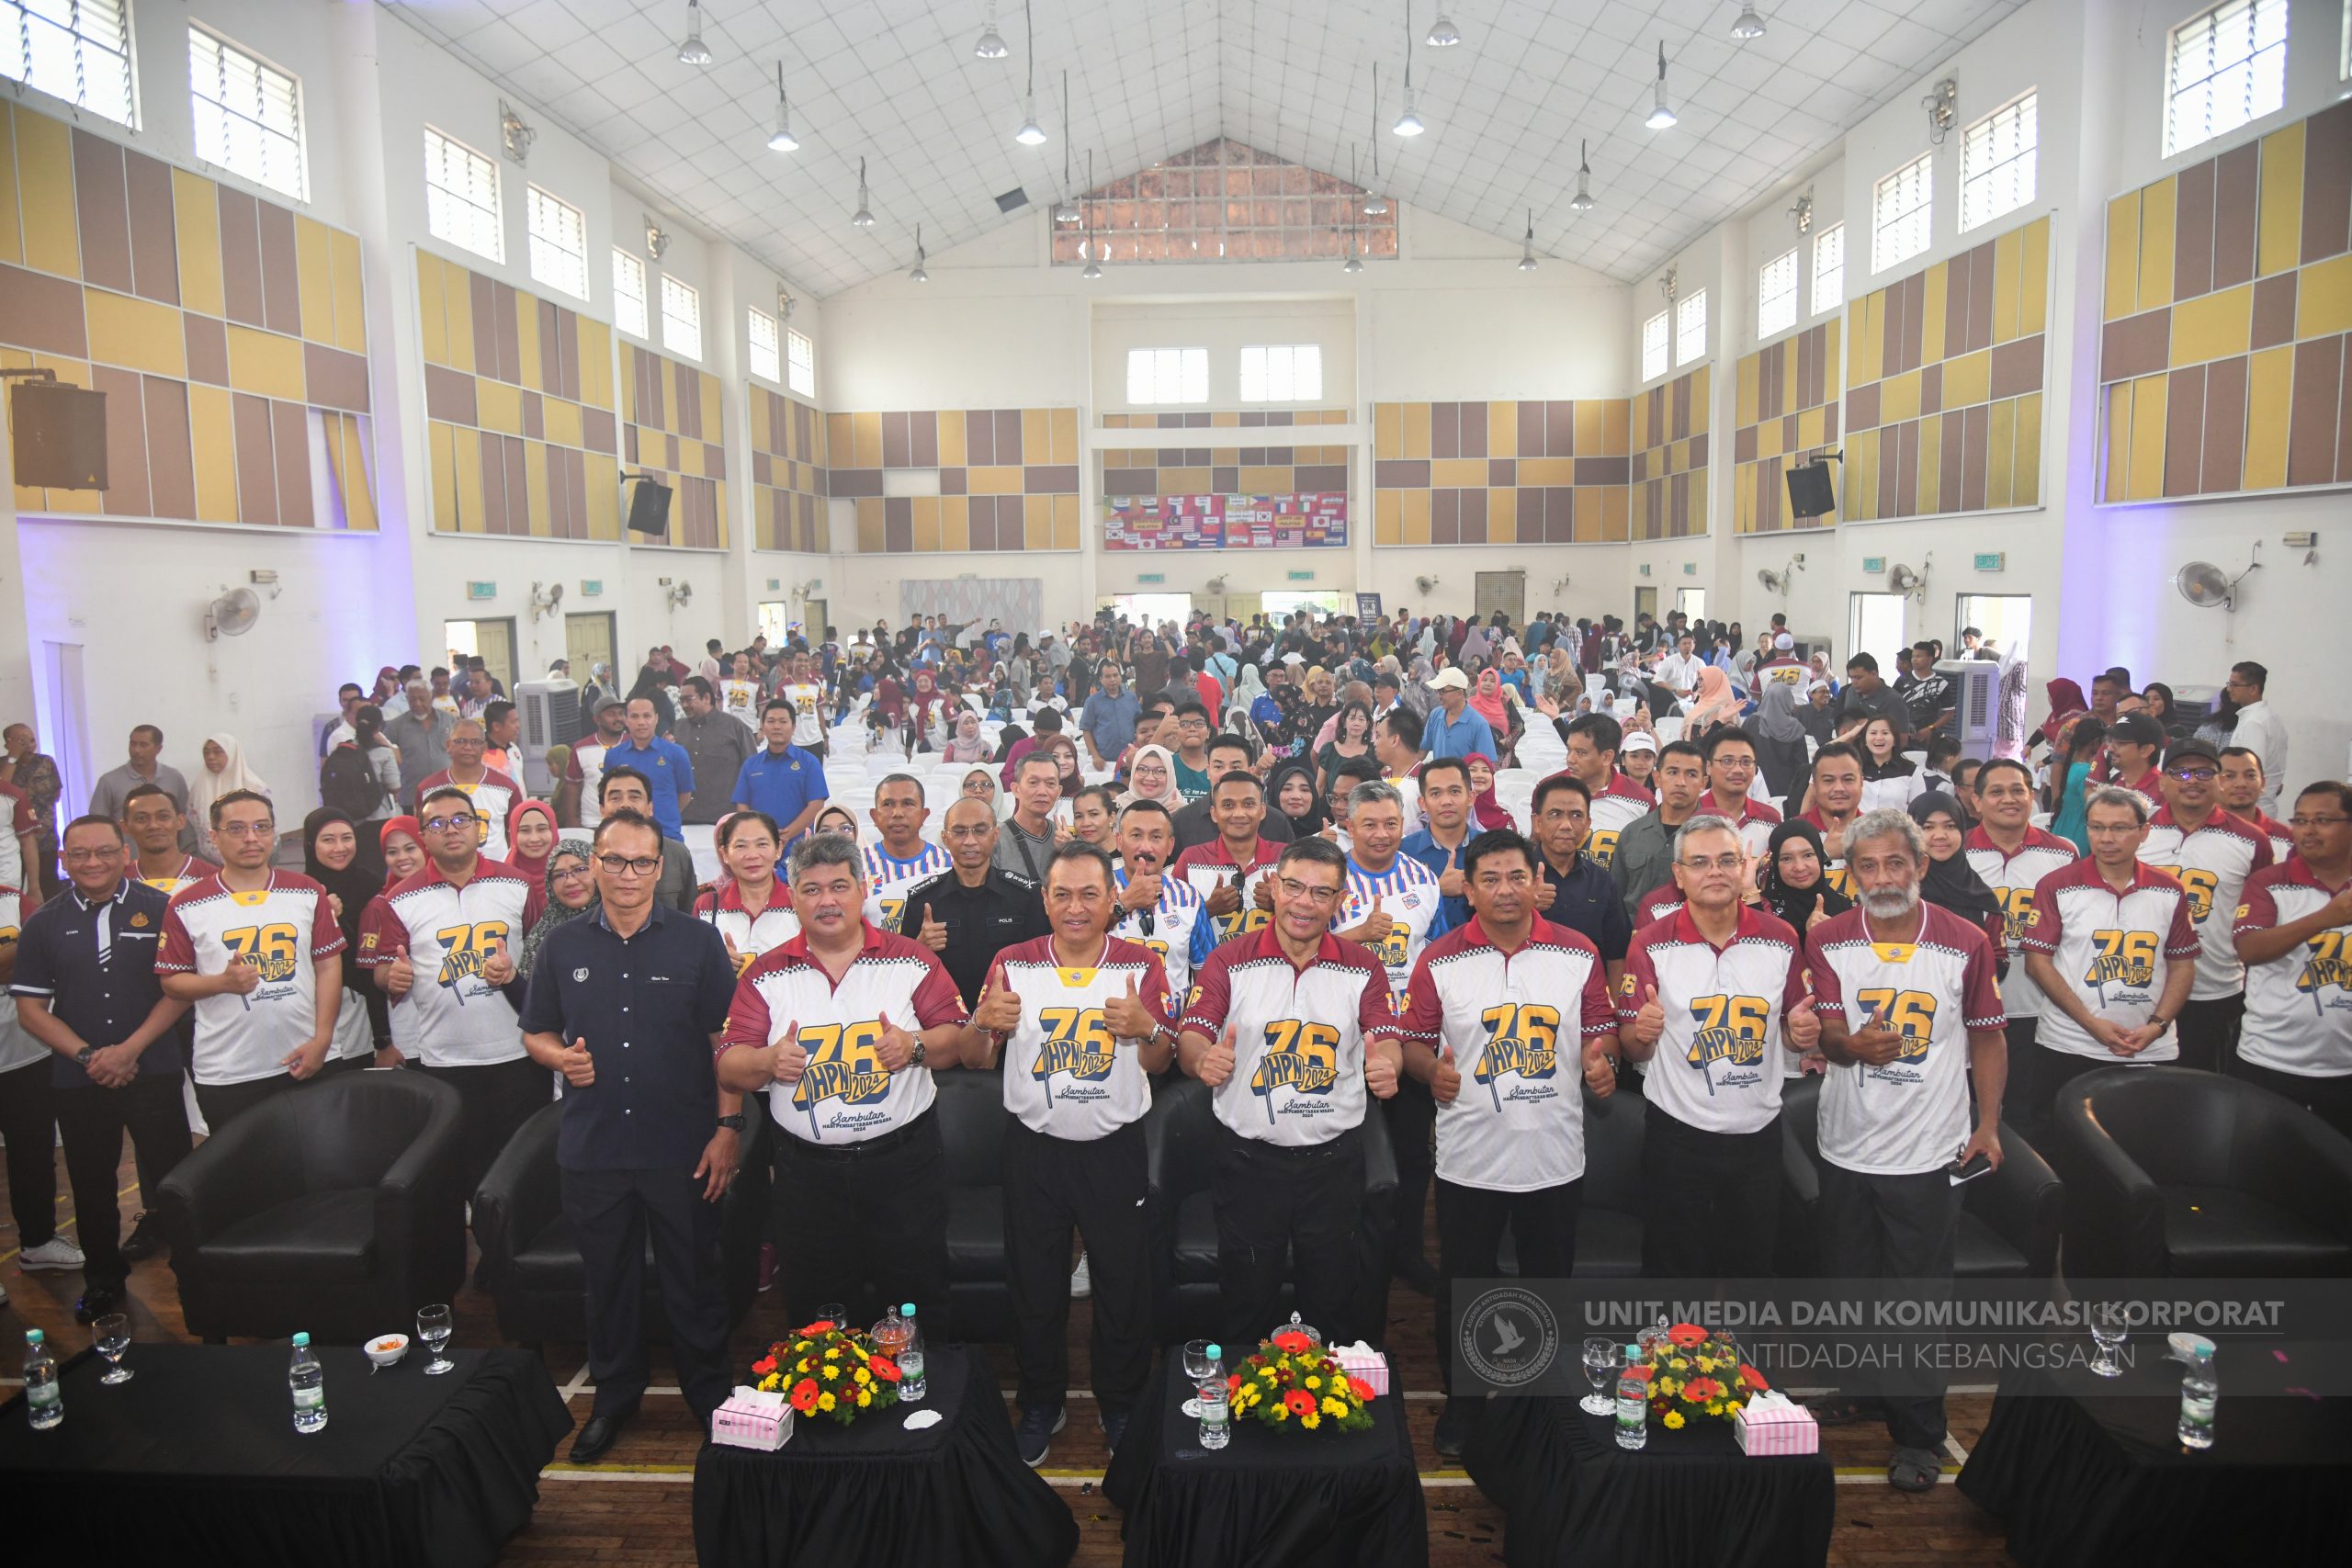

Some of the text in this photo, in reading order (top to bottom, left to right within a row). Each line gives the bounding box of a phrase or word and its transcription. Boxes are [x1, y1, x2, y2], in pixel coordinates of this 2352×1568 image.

[1771, 668, 1800, 685] 76
[222, 922, 298, 982] 76
[436, 920, 509, 988] 76
[450, 951, 481, 979] HPN
[2084, 930, 2159, 989] 76
[270, 962, 290, 979] 2024
[2098, 956, 2129, 982] HPN
[1687, 994, 1770, 1069] 76
[1857, 988, 1938, 1065] 76
[1032, 1007, 1116, 1081] 76
[1046, 1041, 1080, 1073] HPN
[1250, 1019, 1340, 1096] 76
[1474, 1003, 1560, 1085] 76
[1490, 1040, 1525, 1075] HPN
[1702, 1028, 1736, 1060] HPN
[1739, 1041, 1758, 1061] 2024
[793, 1020, 891, 1111] 76
[1081, 1055, 1105, 1077] 2024
[1266, 1055, 1302, 1087] HPN
[1306, 1067, 1330, 1089] 2024
[1528, 1053, 1551, 1075] 2024
[808, 1063, 850, 1100] HPN
[853, 1073, 880, 1100] 2024
[1061, 1085, 1105, 1096] Sambutan
[1510, 1085, 1555, 1097] Sambutan
[831, 1111, 886, 1125] Sambutan
[1283, 1099, 1330, 1111] Sambutan
